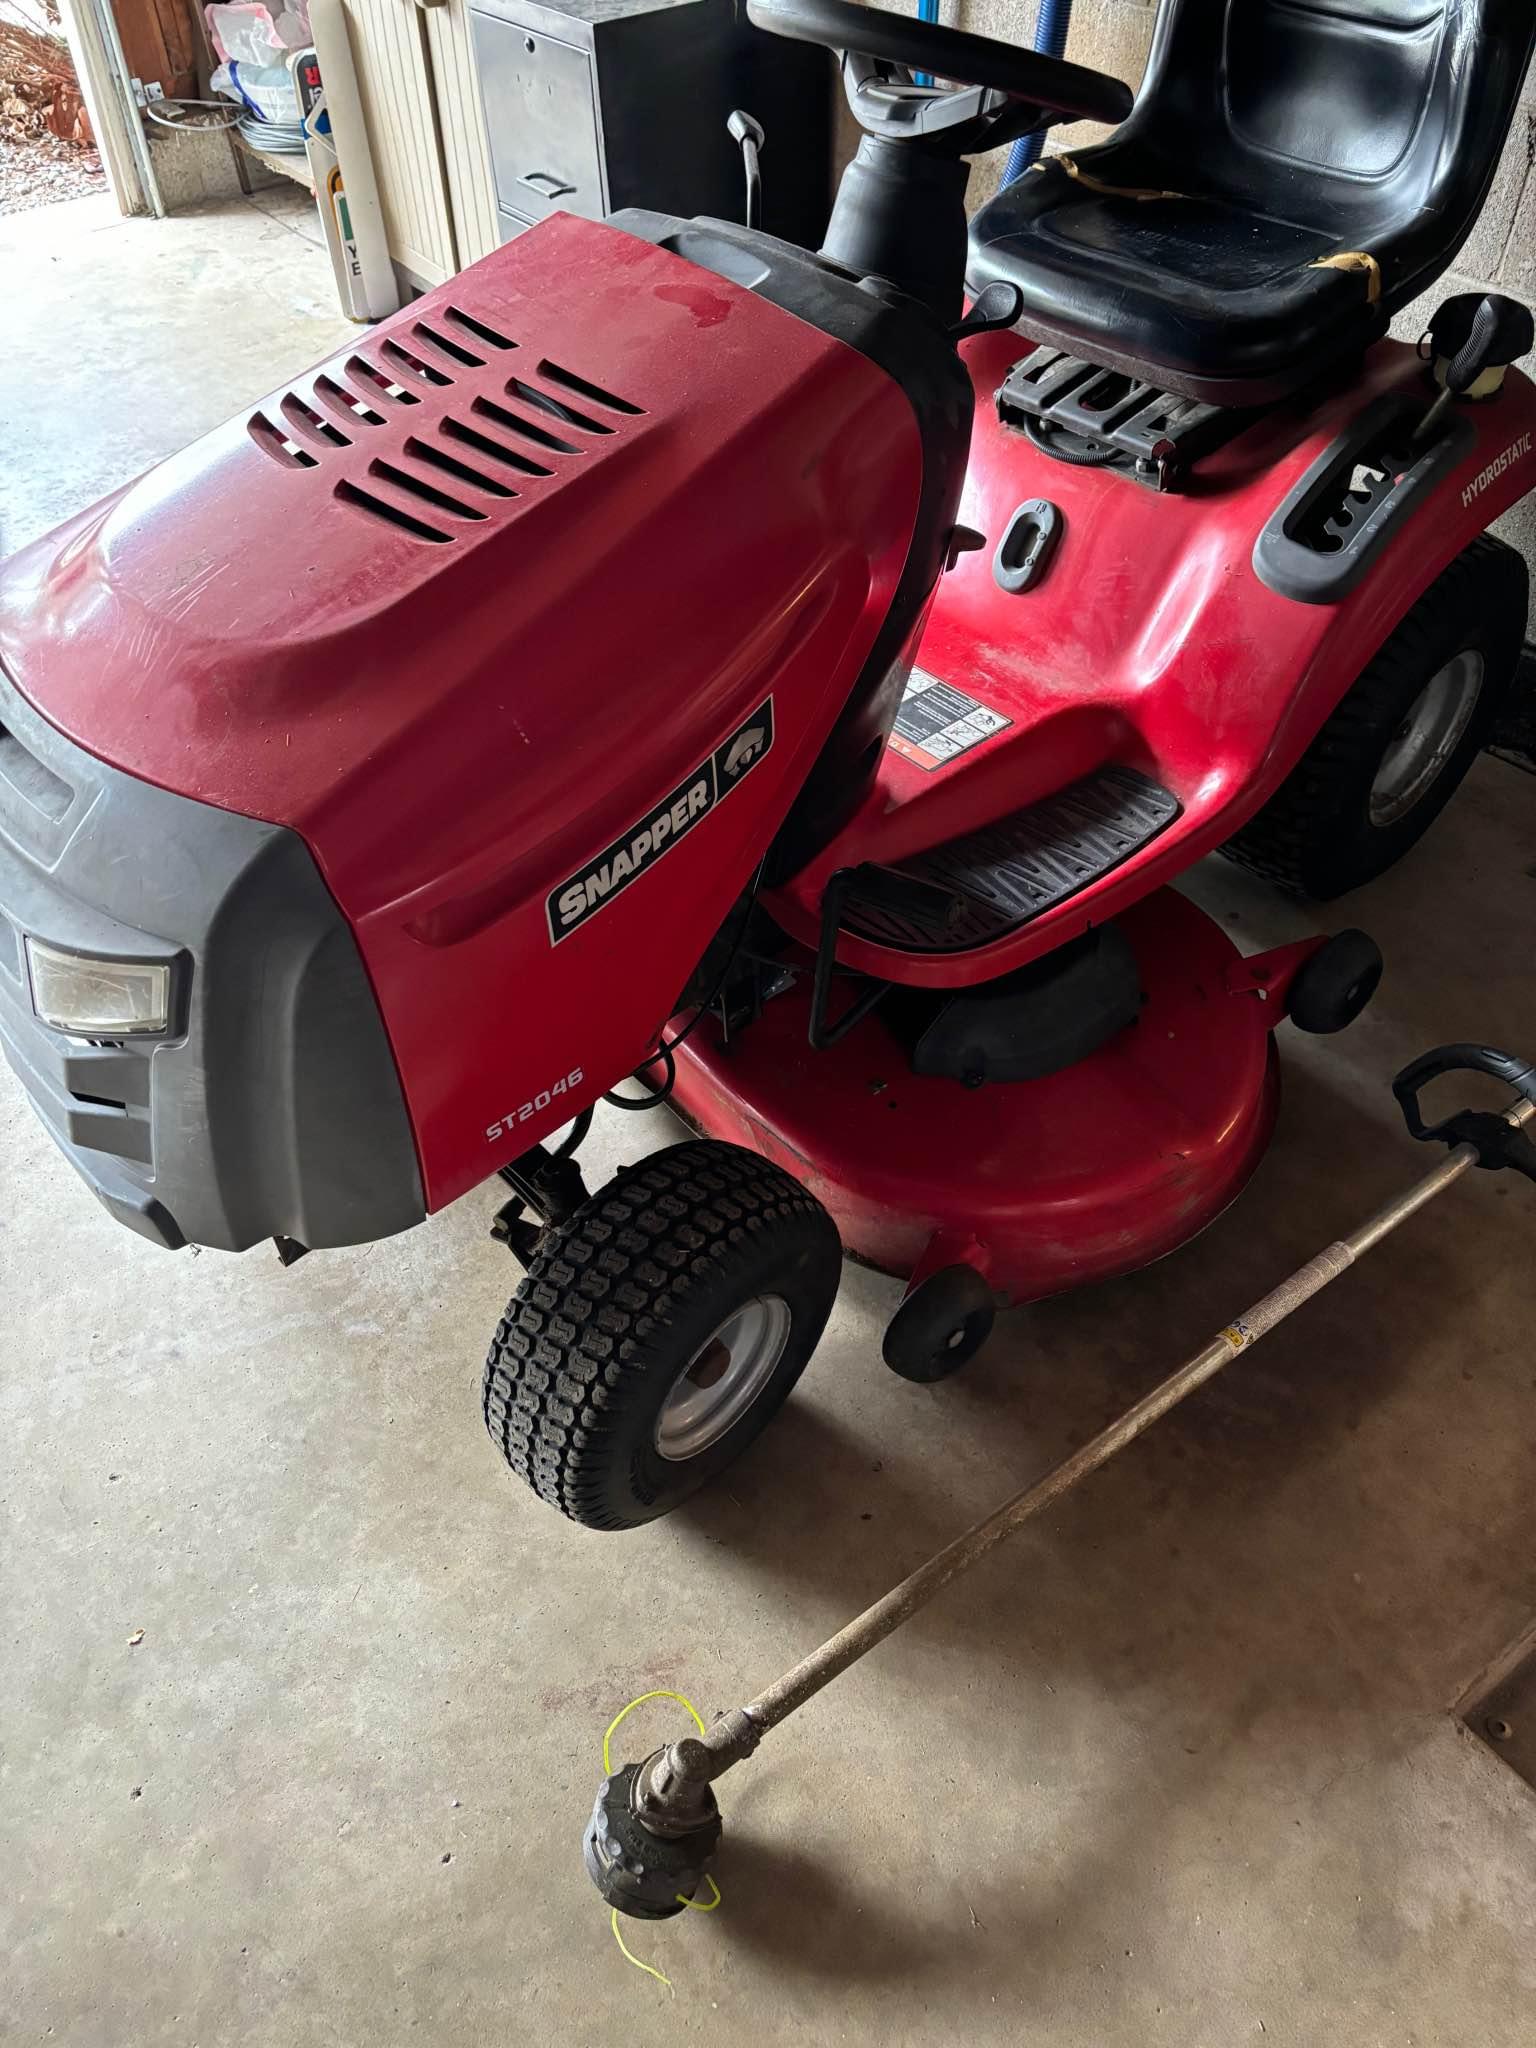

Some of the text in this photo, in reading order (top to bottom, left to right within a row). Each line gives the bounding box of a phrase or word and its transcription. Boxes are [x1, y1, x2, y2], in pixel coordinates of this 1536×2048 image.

[1461, 432, 1532, 508] HYDROSTATIC
[558, 779, 709, 926] SNAPPER
[486, 1067, 584, 1143] ST2046
